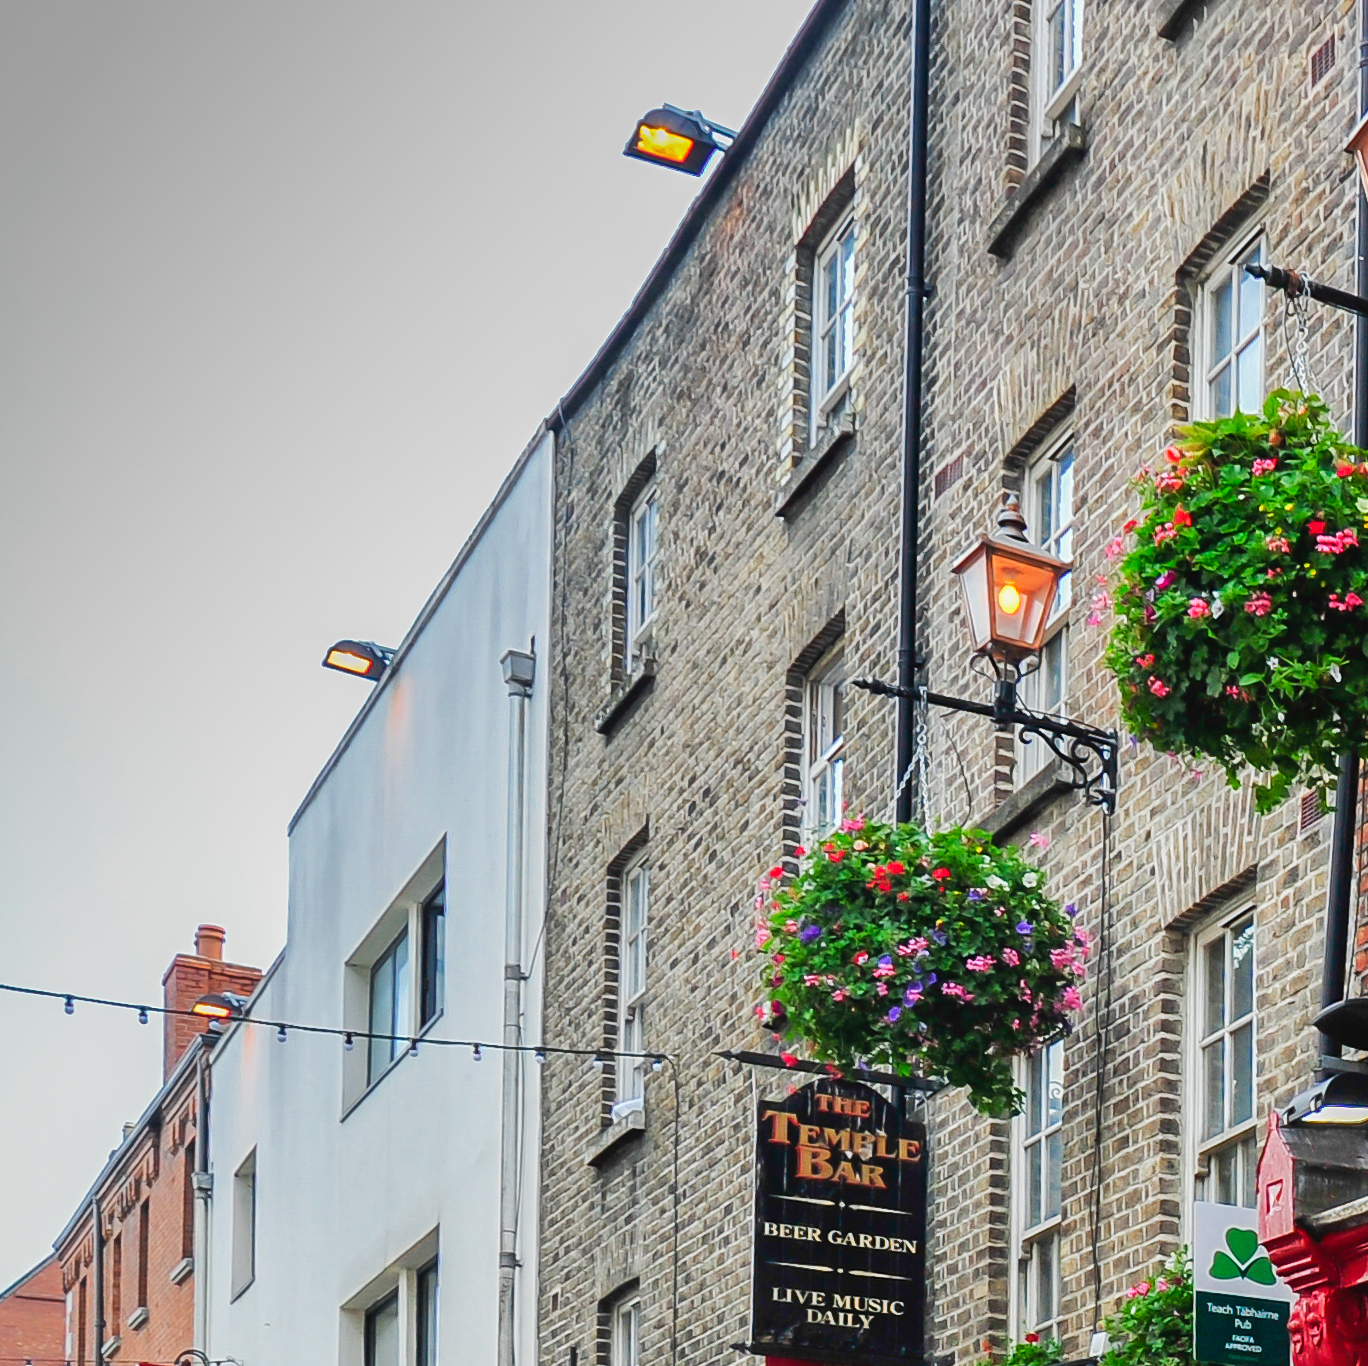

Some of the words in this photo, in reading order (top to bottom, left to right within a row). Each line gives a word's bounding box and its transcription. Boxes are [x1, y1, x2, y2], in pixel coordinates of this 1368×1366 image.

[815, 1093, 870, 1119] THE
[762, 1110, 921, 1162] TEMPLE
[796, 1145, 887, 1189] BAR
[764, 1222, 822, 1242] BEER
[827, 1229, 917, 1254] GARDEN
[772, 1287, 825, 1307] LIVE
[833, 1294, 905, 1316] MUSIC
[1207, 1302, 1234, 1316] Teach
[806, 1308, 874, 1329] DAILY
[1234, 1318, 1252, 1330] Pub
